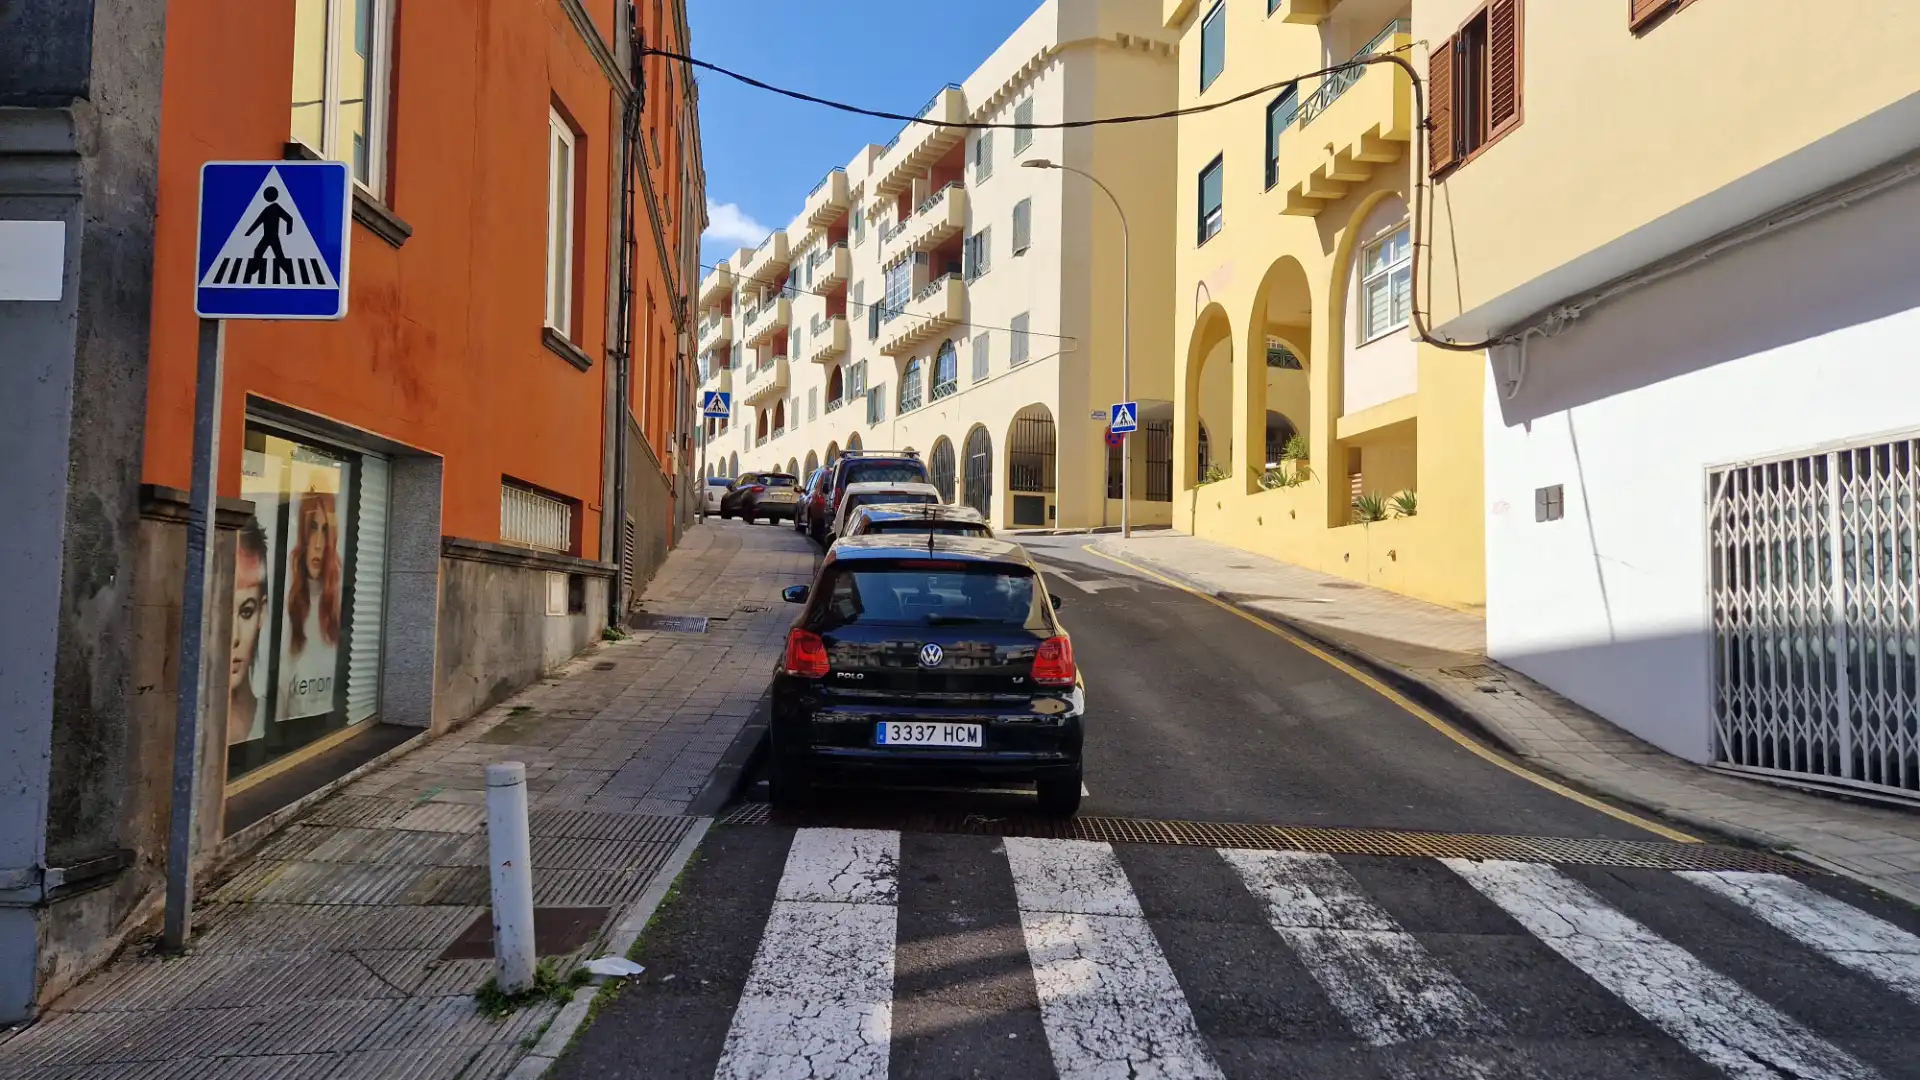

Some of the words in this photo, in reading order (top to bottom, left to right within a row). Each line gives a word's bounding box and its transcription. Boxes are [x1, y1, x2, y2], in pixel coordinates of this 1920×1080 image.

[837, 672, 864, 680] POLO
[891, 724, 937, 742] 3337
[943, 725, 978, 743] HCM
